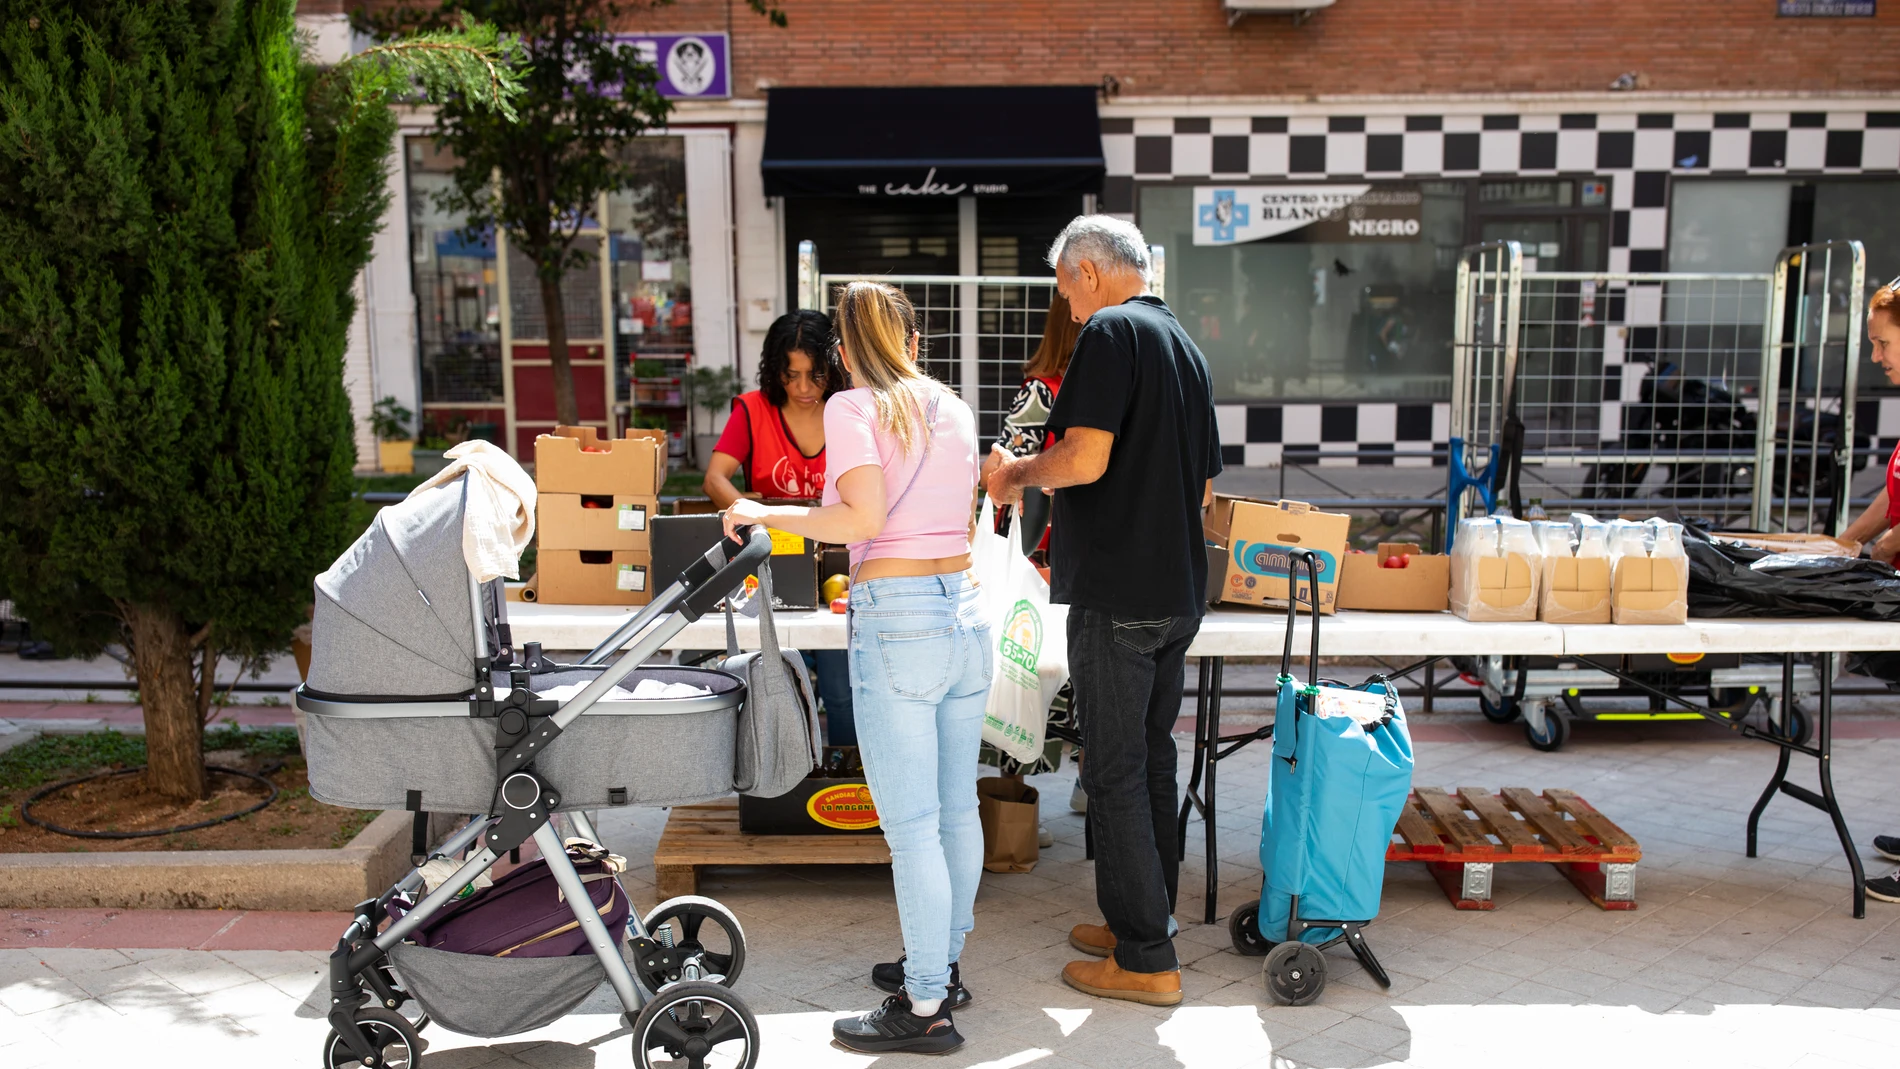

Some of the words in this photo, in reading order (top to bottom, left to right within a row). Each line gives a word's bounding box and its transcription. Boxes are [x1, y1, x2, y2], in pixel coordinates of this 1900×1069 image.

[858, 184, 877, 194] THE
[884, 166, 967, 195] cake
[973, 183, 1009, 194] STUDIO
[1262, 194, 1319, 204] CENTRO
[1262, 207, 1344, 220] BLANCO
[1349, 219, 1420, 236] NEGRO
[825, 791, 855, 803] SANDIAS
